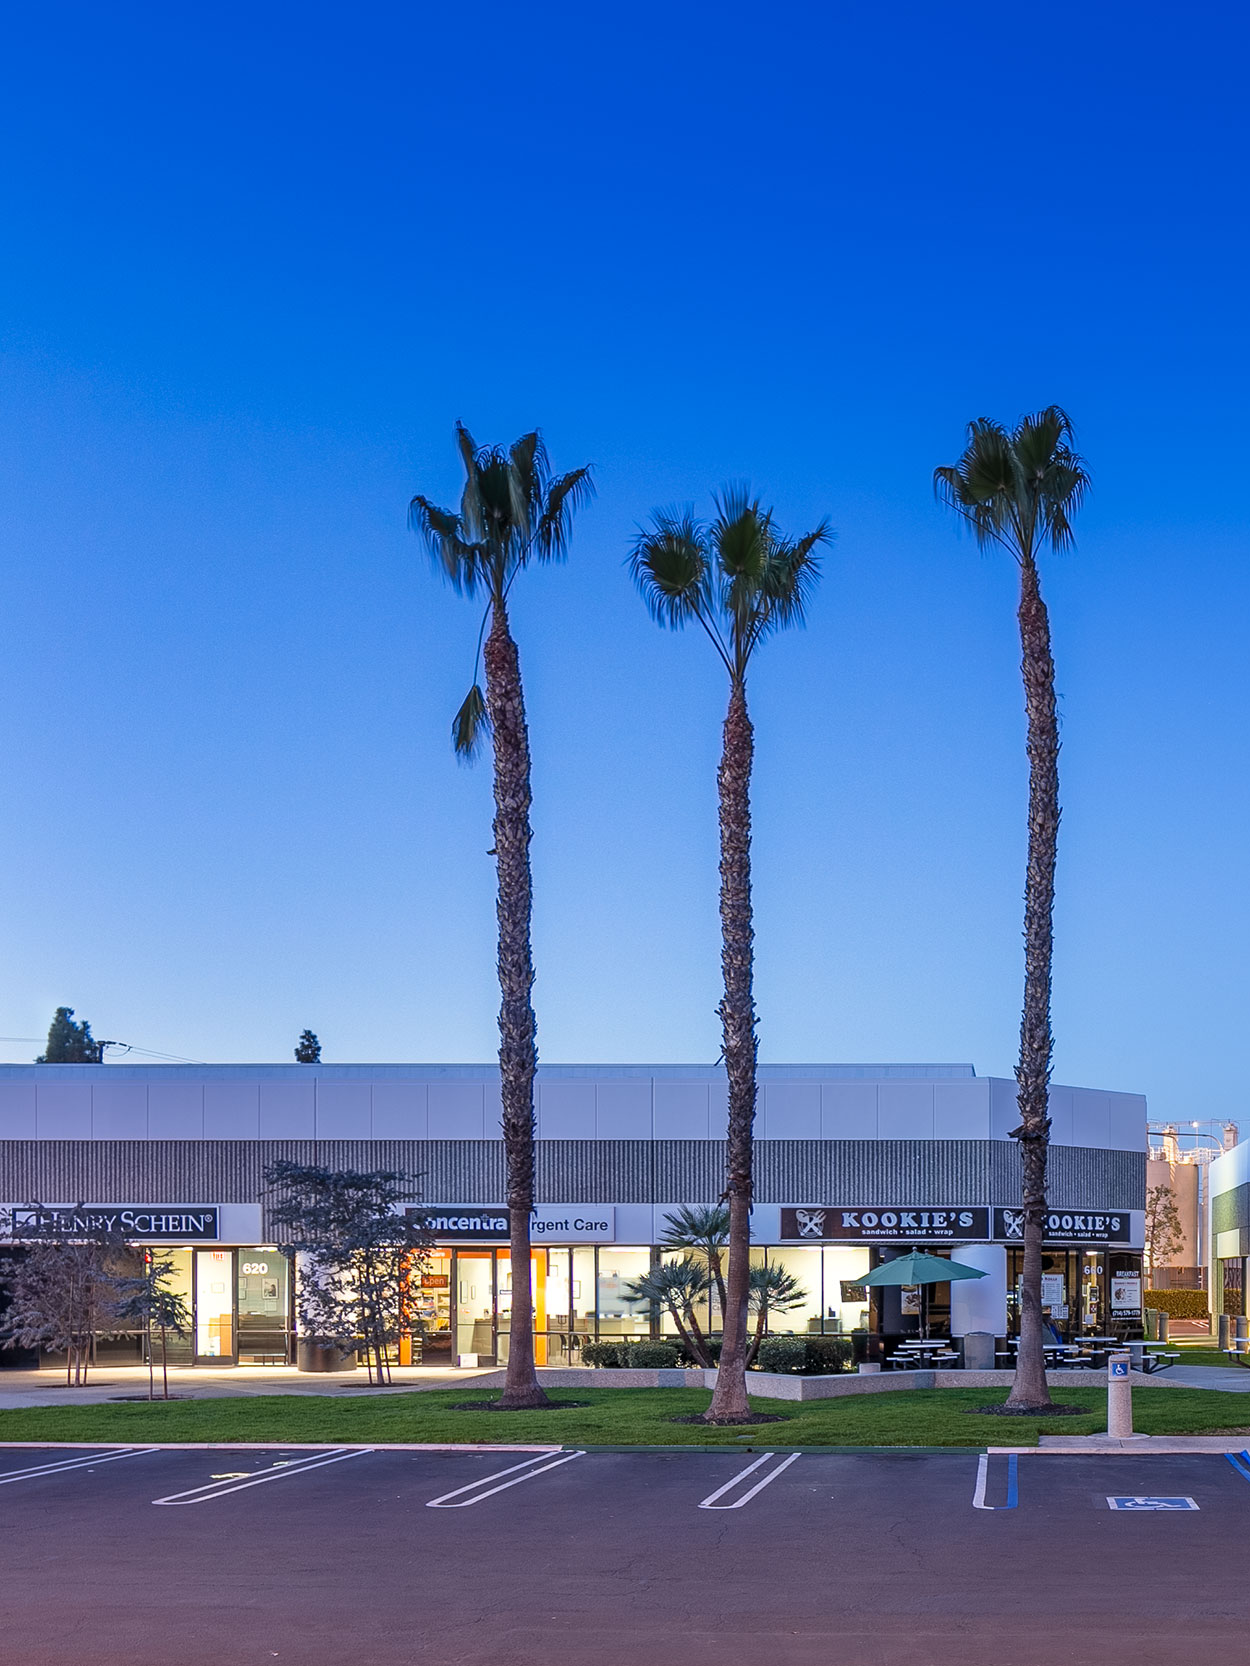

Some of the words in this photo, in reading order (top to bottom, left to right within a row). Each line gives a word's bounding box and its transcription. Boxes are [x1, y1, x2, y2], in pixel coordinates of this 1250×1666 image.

[412, 1213, 508, 1230] oncentra
[530, 1218, 569, 1233] rgent
[573, 1218, 609, 1231] Care
[841, 1212, 974, 1228] KOOKIE'S
[1041, 1214, 1121, 1232] OOKIE'S
[861, 1228, 898, 1236] sandwich
[905, 1228, 927, 1236] salad
[933, 1229, 954, 1237] wrap
[242, 1262, 269, 1275] 620
[1083, 1265, 1104, 1275] 660
